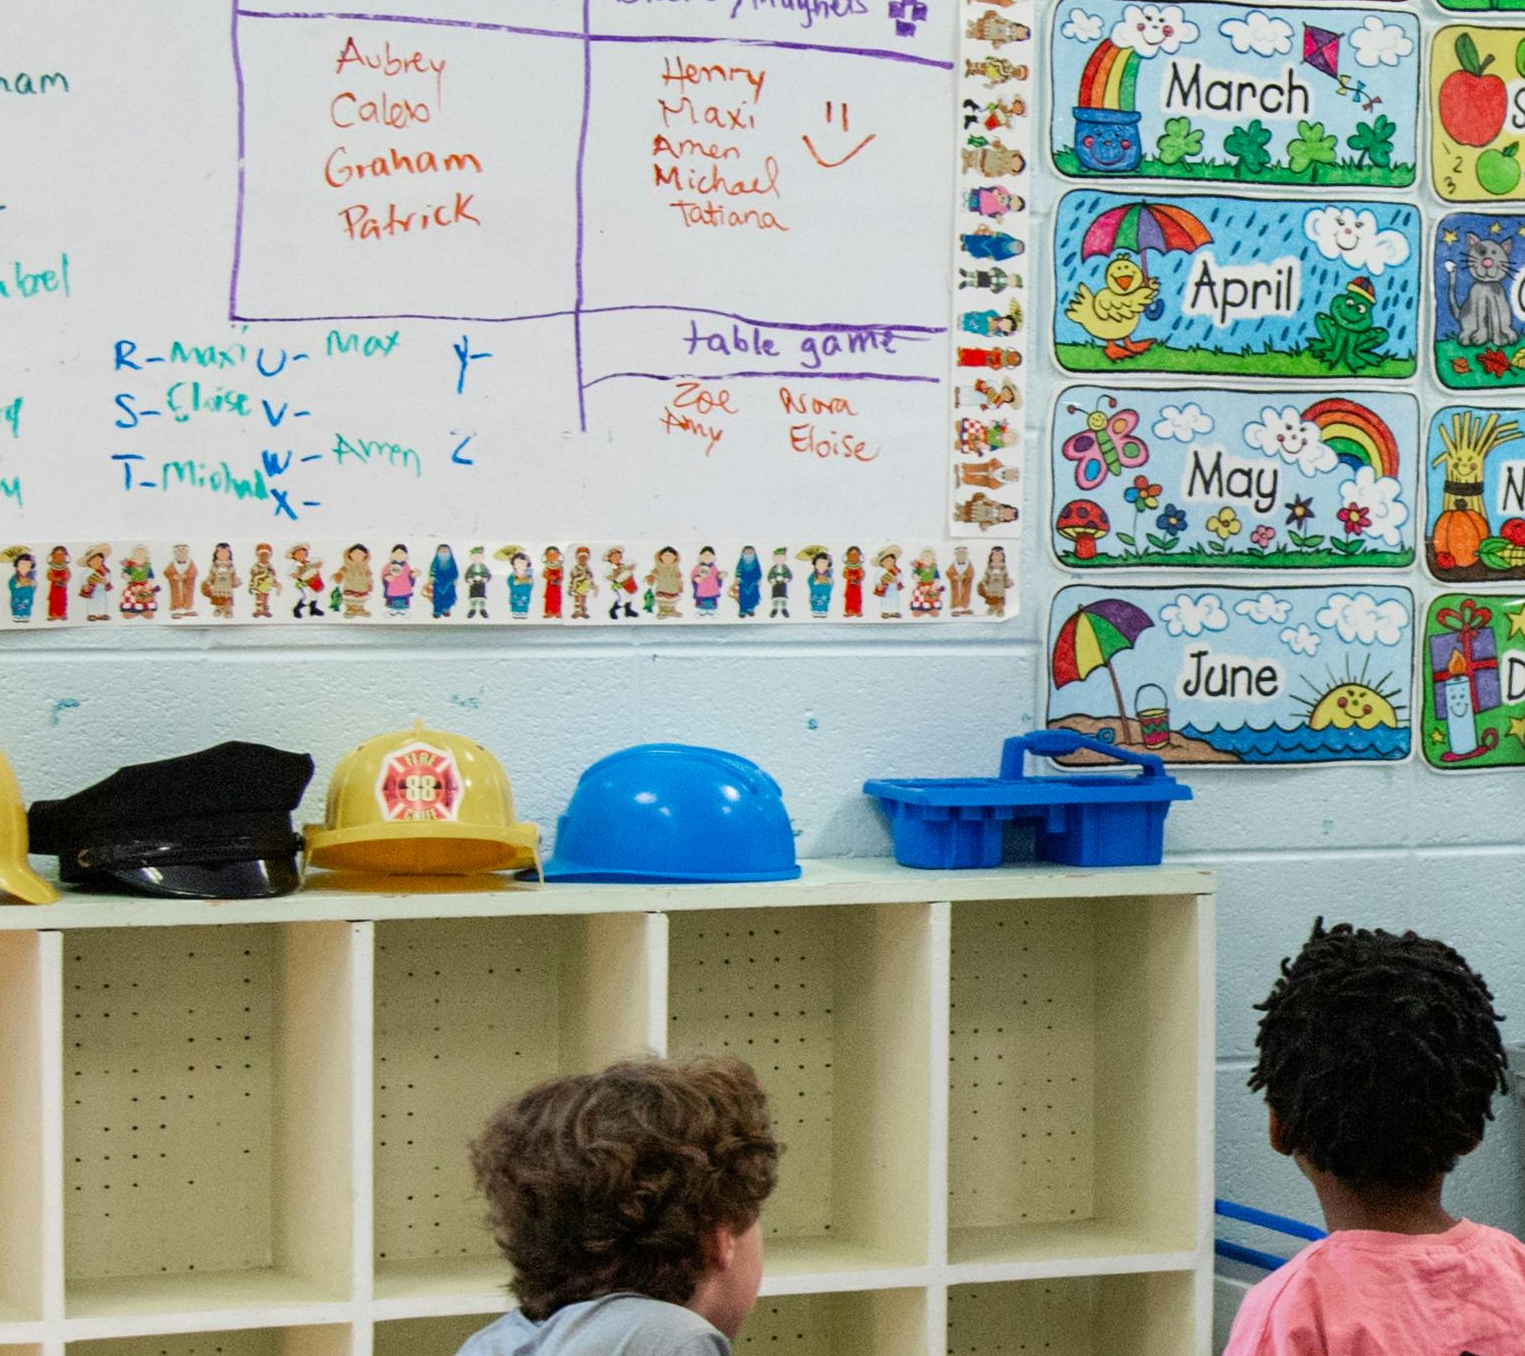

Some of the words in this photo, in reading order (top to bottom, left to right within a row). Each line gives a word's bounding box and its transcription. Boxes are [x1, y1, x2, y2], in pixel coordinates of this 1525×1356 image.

[331, 36, 446, 120] Aubrey
[662, 56, 765, 103] Henry
[1166, 61, 1310, 116] March
[331, 91, 430, 129] Caleb
[658, 97, 754, 130] Maxi
[653, 134, 740, 159] Amen
[324, 147, 482, 188] Graham
[653, 156, 779, 196] Michael
[338, 193, 480, 239] Patrick
[669, 200, 789, 231] Tatiana
[1191, 264, 1294, 324] April
[683, 321, 779, 356] table
[800, 330, 897, 368] game
[673, 382, 738, 415] Zoe
[779, 387, 856, 416] Nora
[789, 424, 877, 462] Eloise
[1190, 451, 1278, 512] May
[1182, 650, 1279, 700] June
[406, 775, 436, 802] 88
